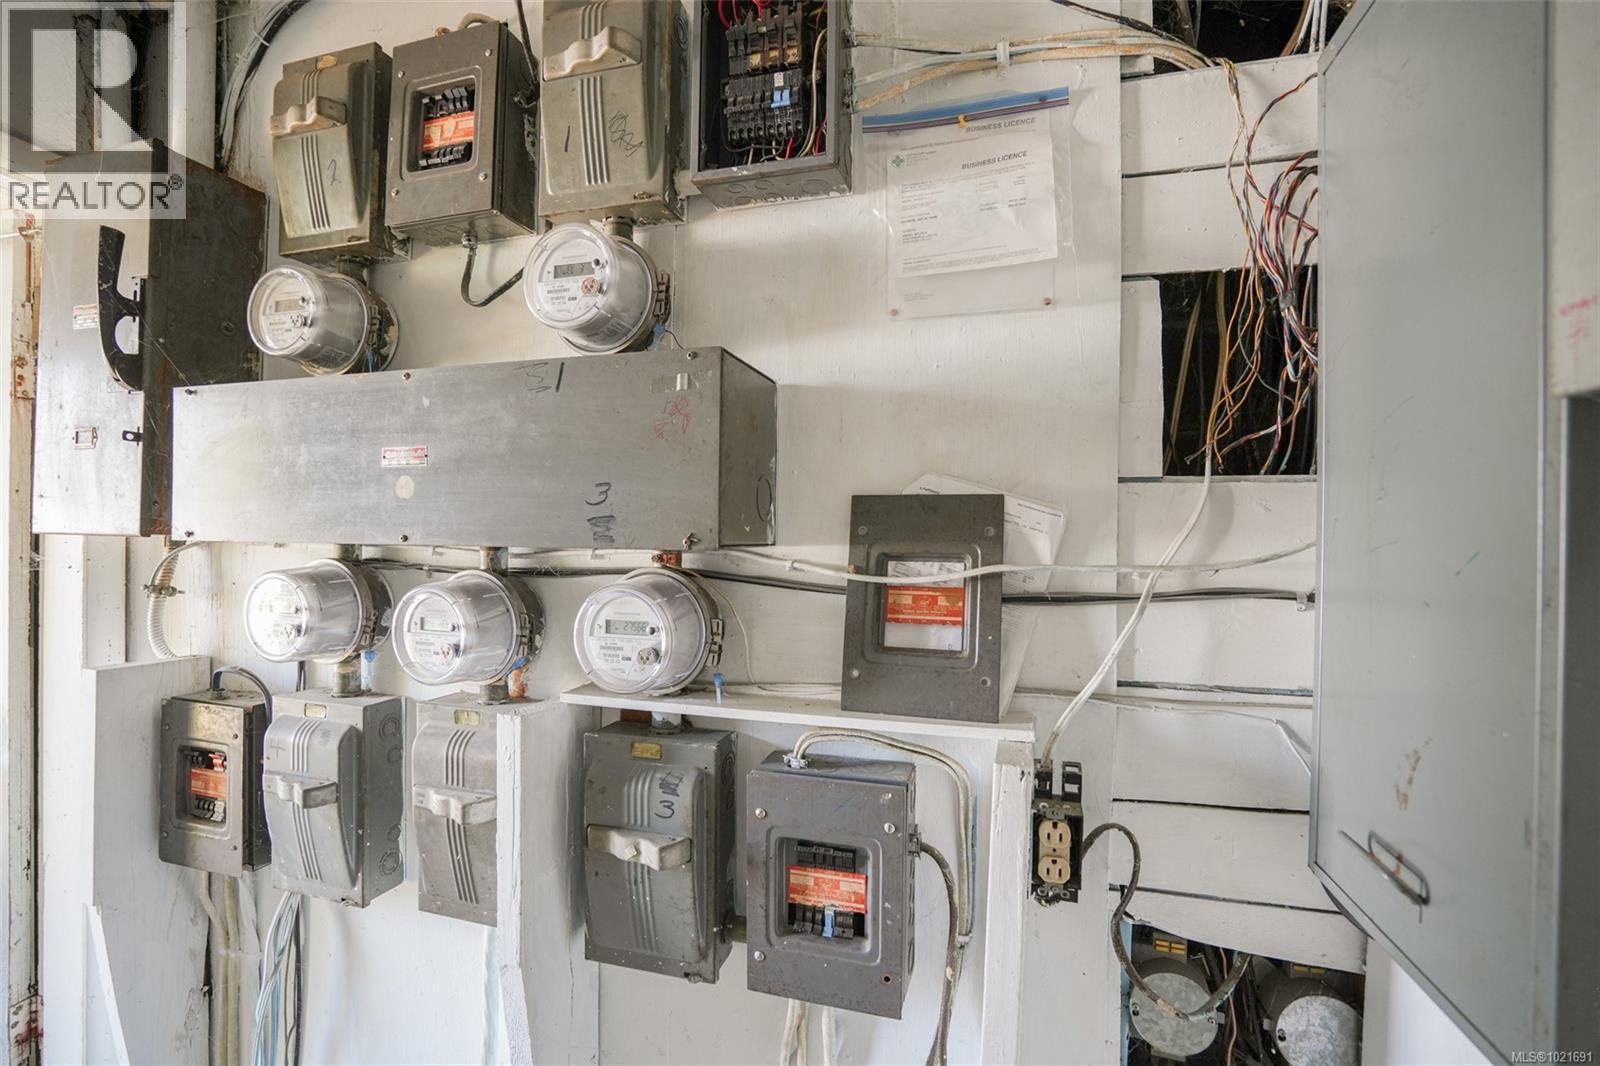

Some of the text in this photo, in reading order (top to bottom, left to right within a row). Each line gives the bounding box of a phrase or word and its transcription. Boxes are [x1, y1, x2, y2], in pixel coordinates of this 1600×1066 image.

[965, 117, 1036, 133] BUSINESS LICENCE
[961, 150, 1028, 170] BUSINESS LICENCE
[585, 482, 612, 506] 3
[654, 799, 675, 820] 3
